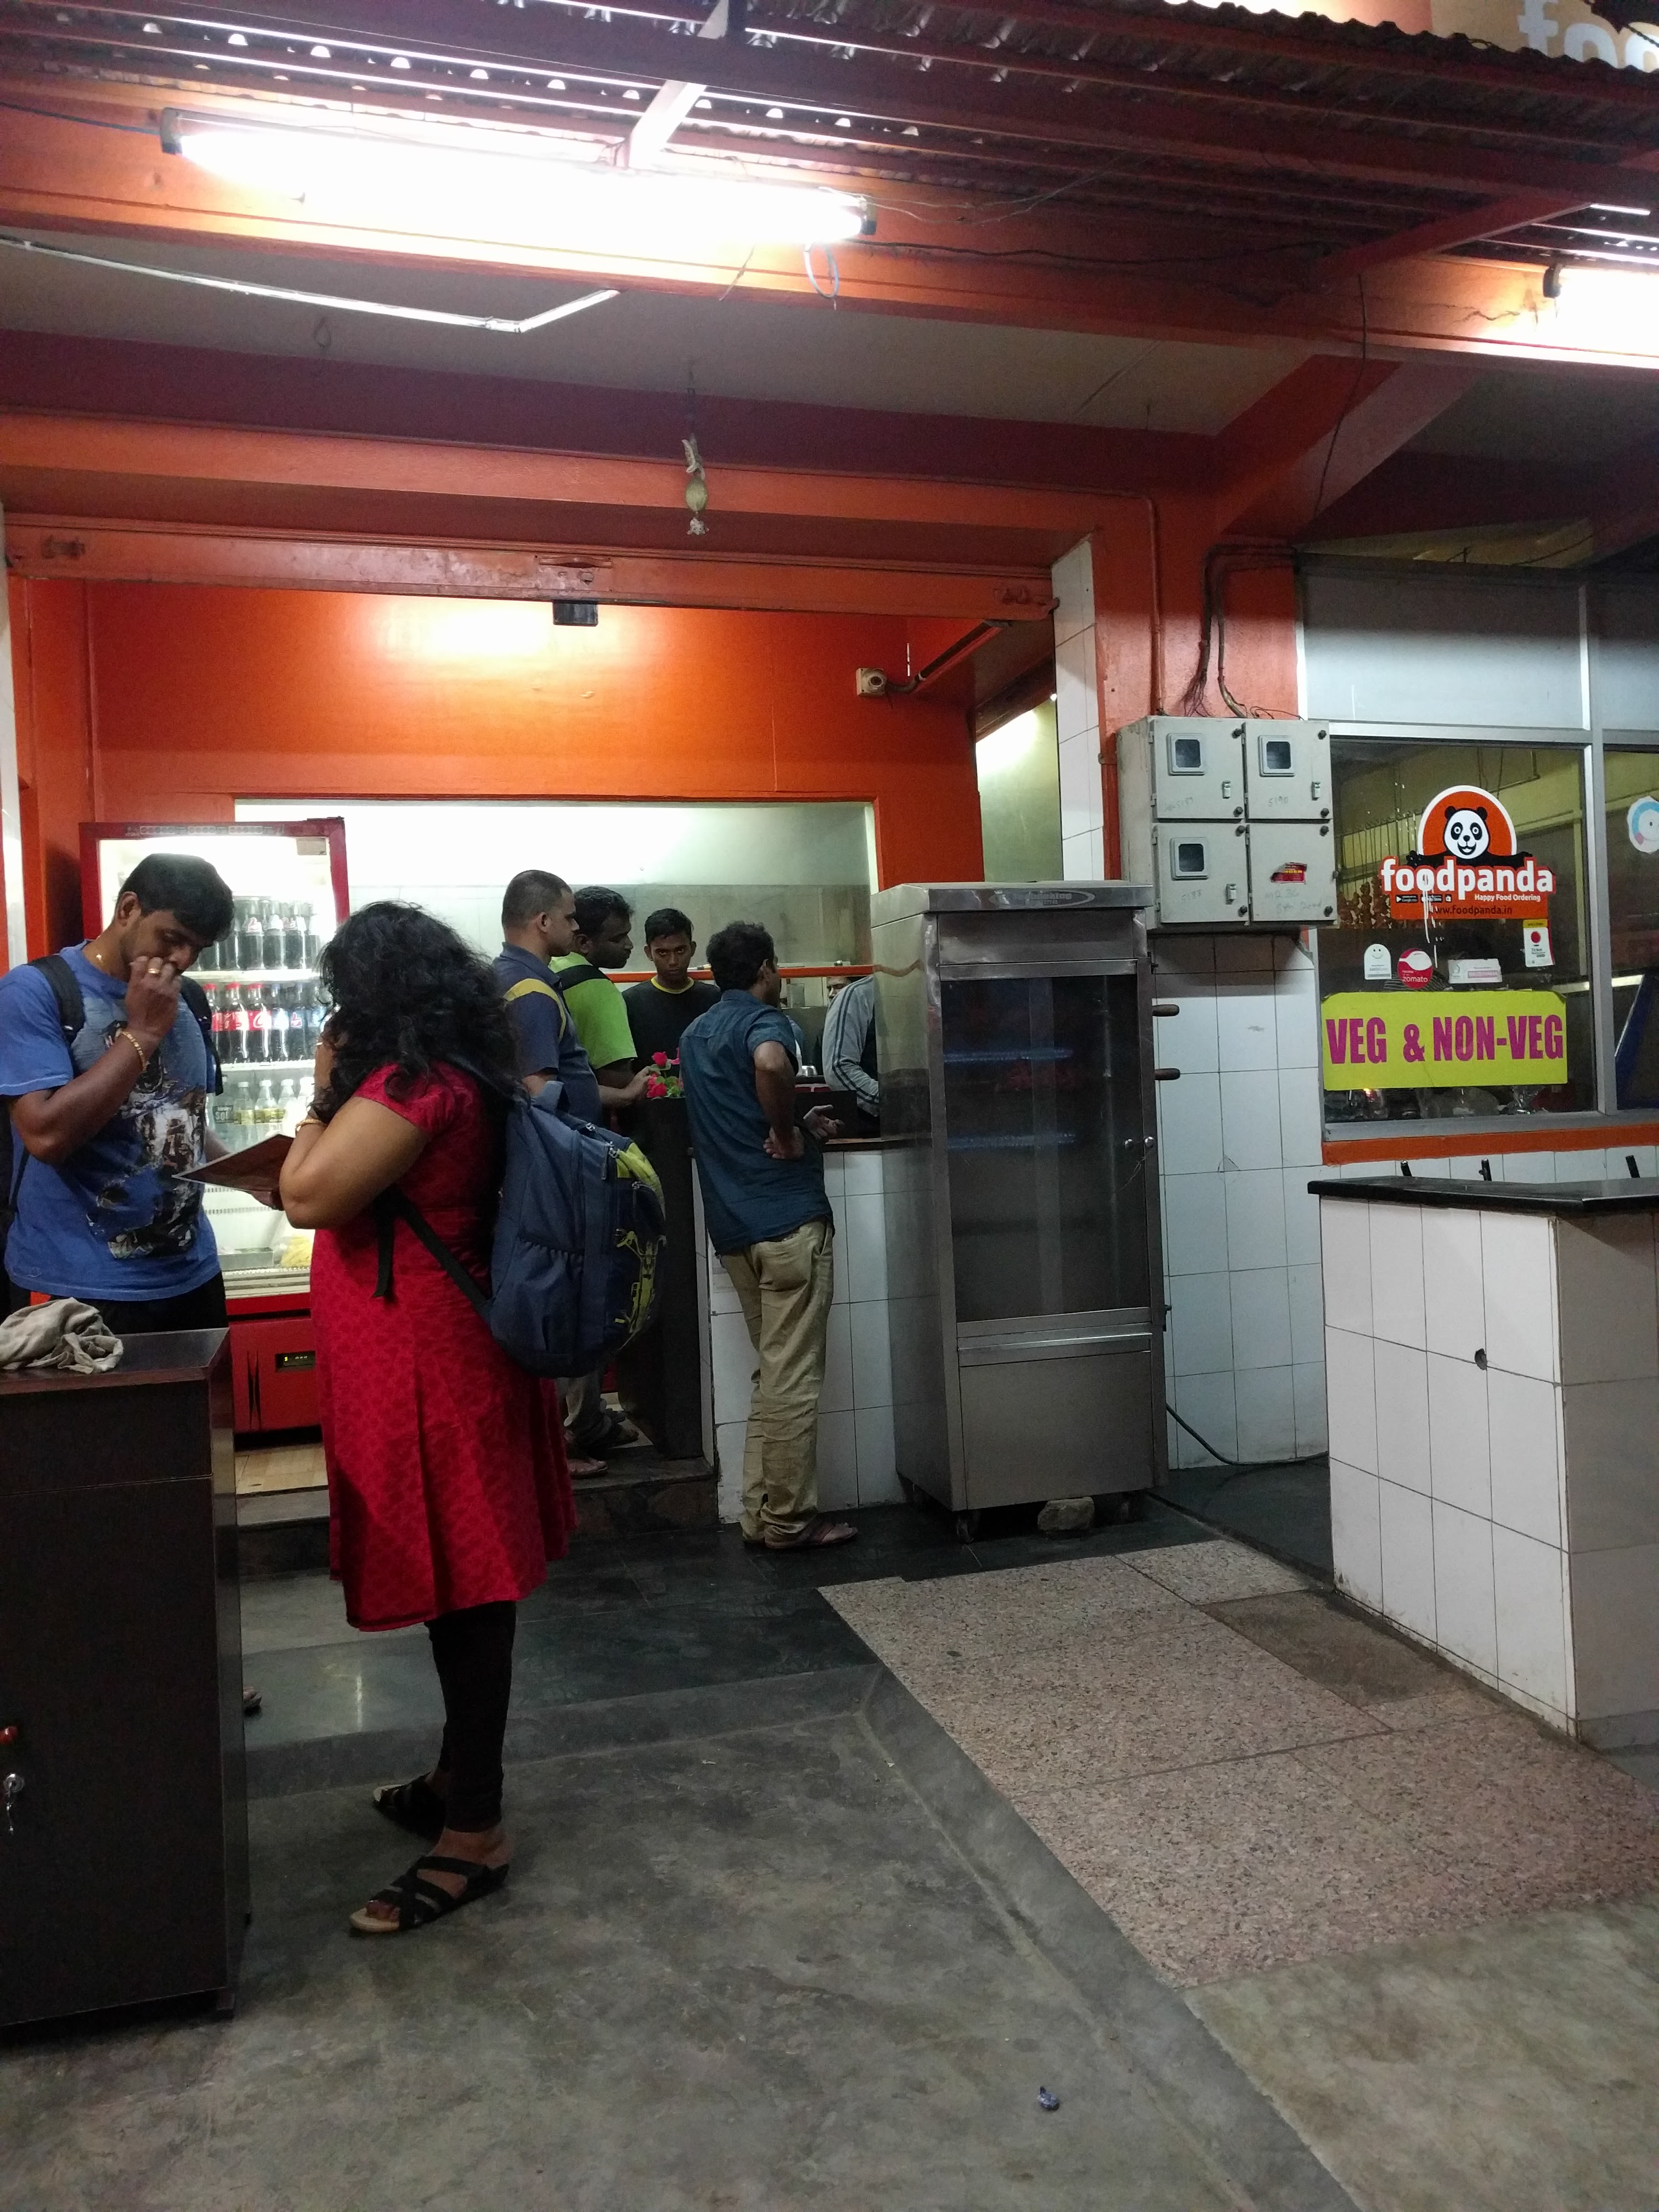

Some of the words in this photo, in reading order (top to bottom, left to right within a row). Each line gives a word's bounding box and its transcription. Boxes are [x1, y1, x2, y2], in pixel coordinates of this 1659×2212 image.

[1381, 859, 1553, 900] foodpanda
[1513, 894, 1541, 902] Ordering
[1325, 1017, 1387, 1064] VEG
[1403, 1024, 1426, 1063] &
[1432, 1014, 1564, 1062] NON-VEG
